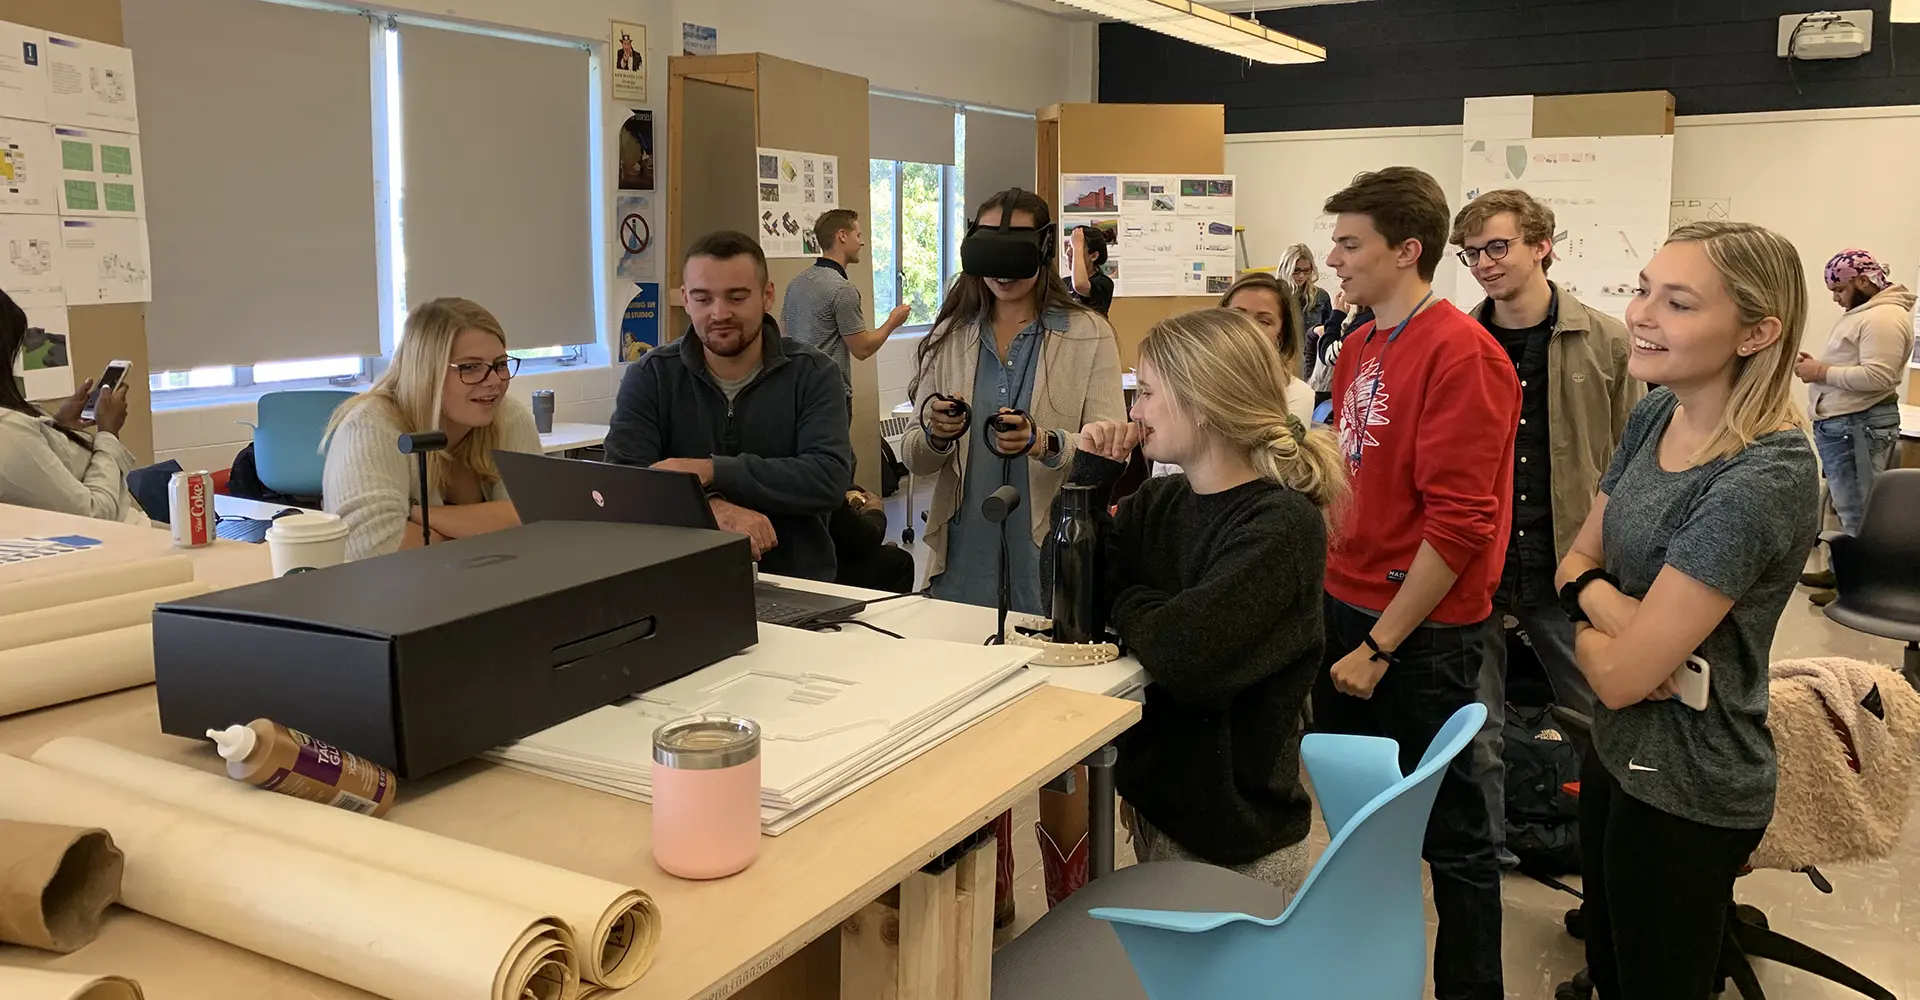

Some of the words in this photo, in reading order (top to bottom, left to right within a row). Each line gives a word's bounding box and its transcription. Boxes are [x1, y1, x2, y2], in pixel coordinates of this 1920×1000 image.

[27, 45, 32, 57] 1
[631, 311, 654, 319] STUDIO
[191, 484, 205, 517] Coke
